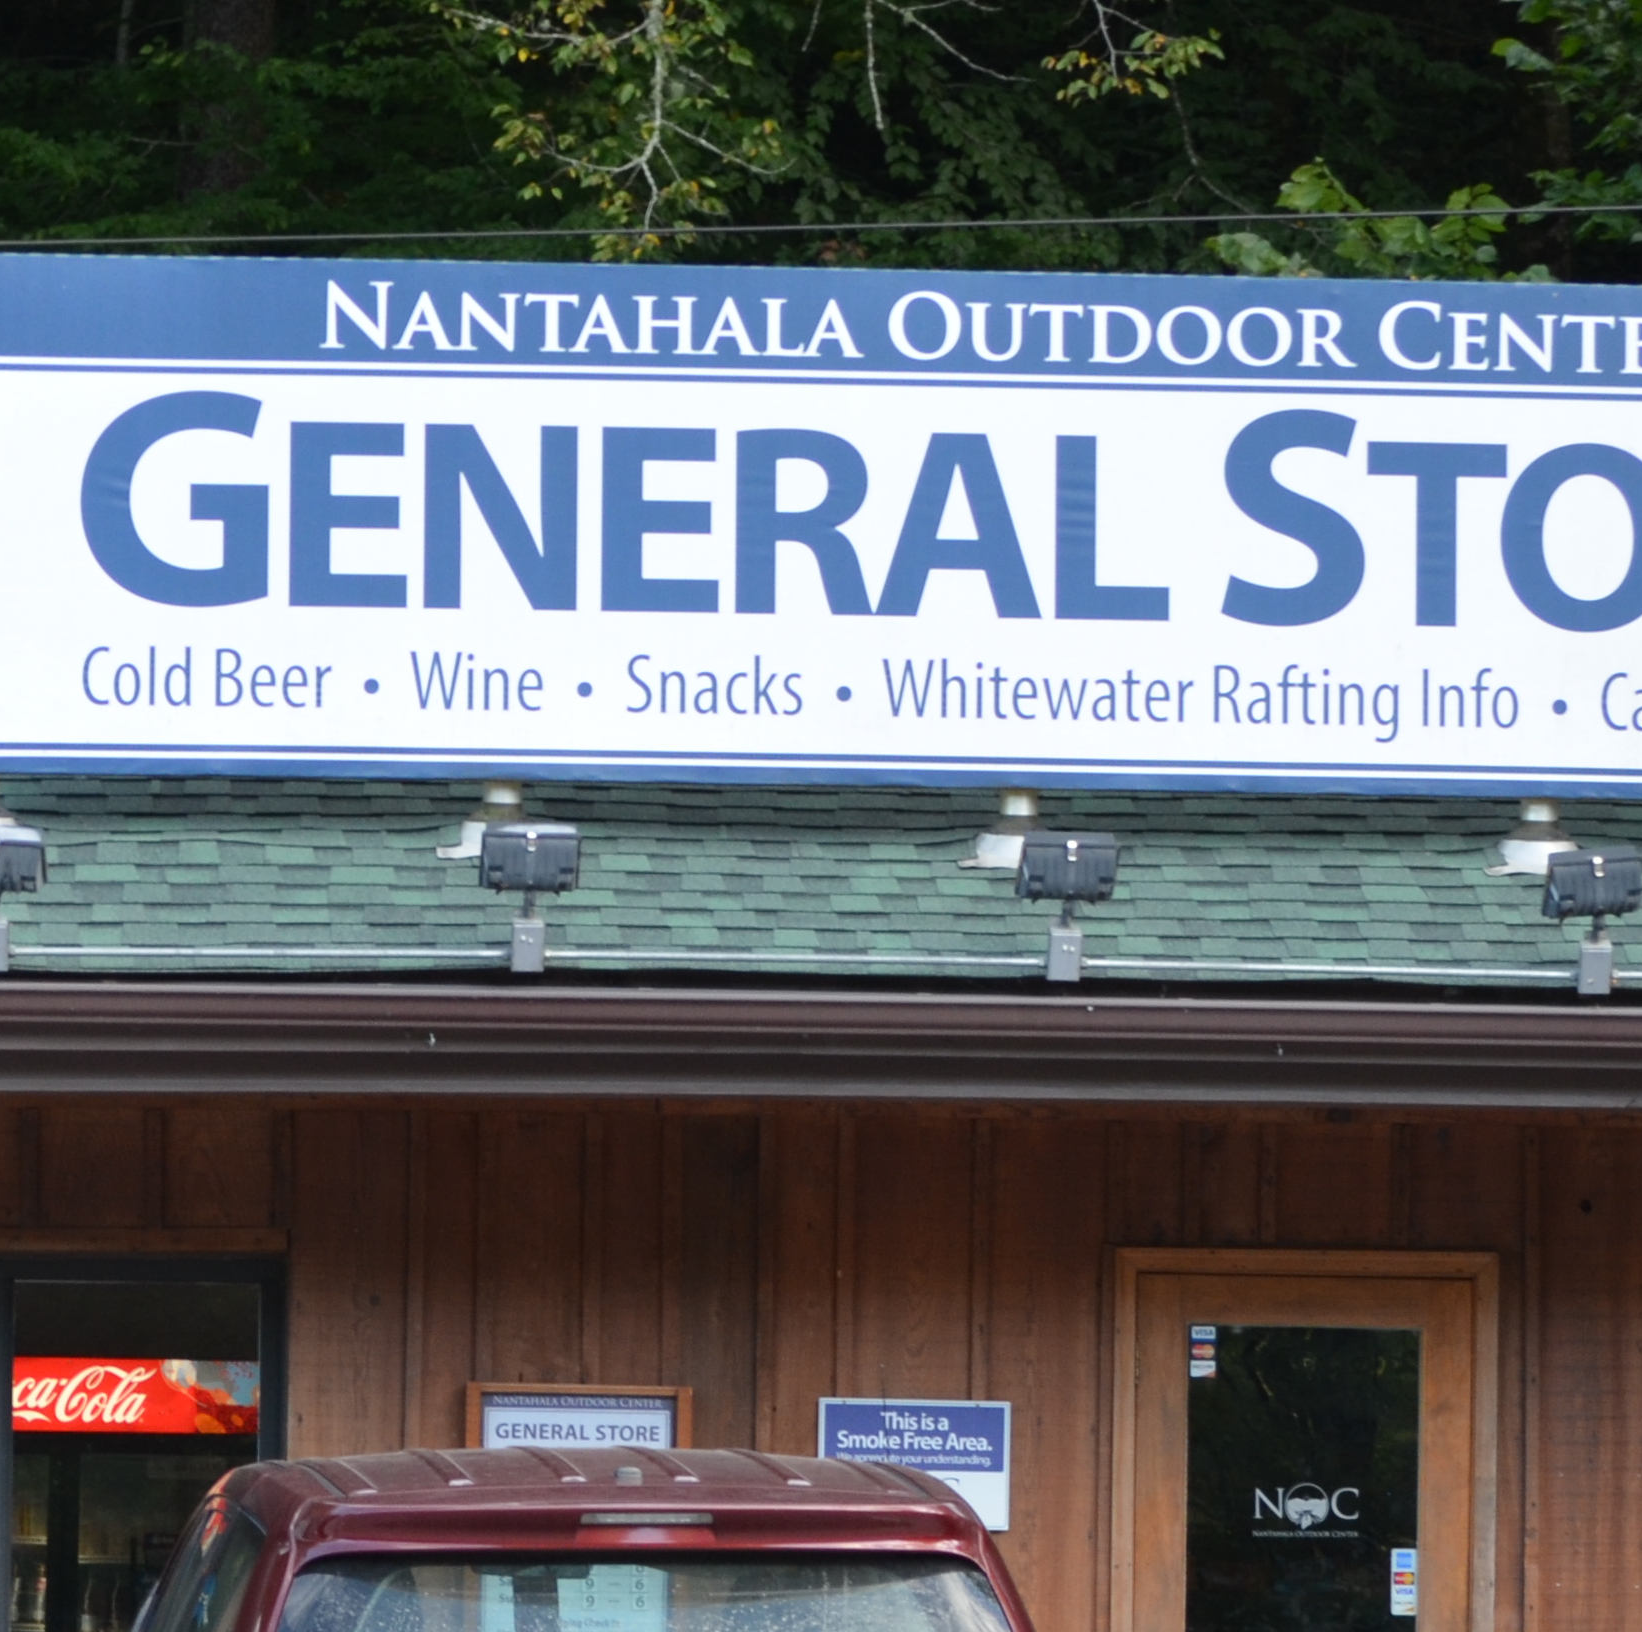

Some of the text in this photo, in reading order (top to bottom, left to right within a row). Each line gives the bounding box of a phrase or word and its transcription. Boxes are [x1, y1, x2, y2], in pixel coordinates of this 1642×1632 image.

[319, 279, 865, 358] NANTAHALA
[888, 290, 1357, 367] OUTDOOR
[79, 390, 1170, 621] GENERAL
[82, 645, 192, 707] Cold
[215, 648, 333, 708] Beer
[409, 651, 544, 712] Wine
[626, 654, 804, 716] Snacks
[882, 658, 1195, 723] Whitewater
[1213, 664, 1400, 744] Rafting
[1422, 667, 1520, 729] Info
[492, 1395, 663, 1409] NANTAHALA OUTDOOR CENTER
[880, 1411, 949, 1431] This is a
[495, 1422, 661, 1442] GENERAL STORE
[836, 1430, 993, 1451] Smoke Free Area.
[901, 1455, 923, 1466] your
